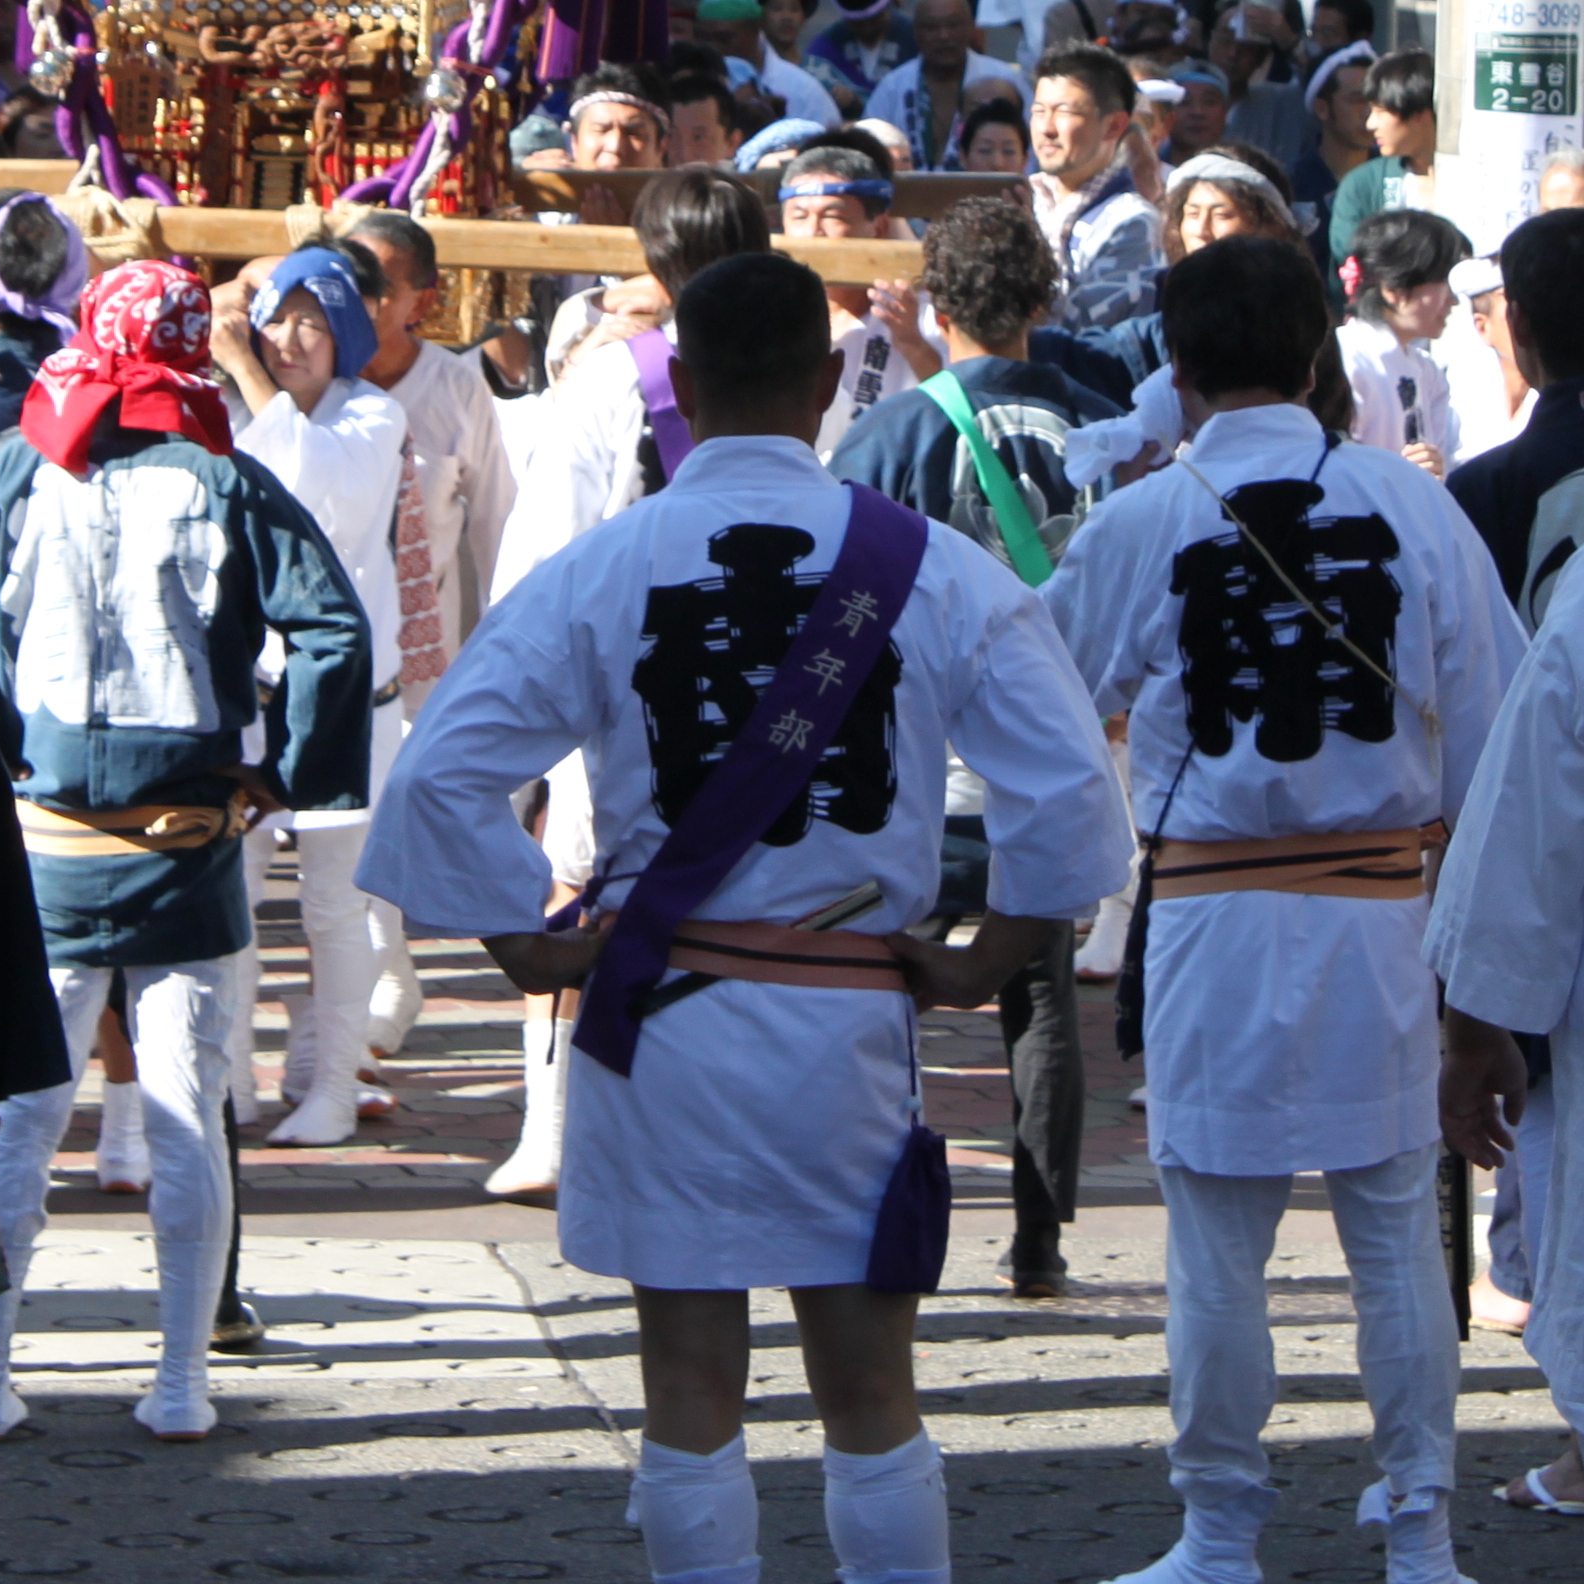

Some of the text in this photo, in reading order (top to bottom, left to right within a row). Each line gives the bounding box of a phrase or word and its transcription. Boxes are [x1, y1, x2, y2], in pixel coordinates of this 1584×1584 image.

[1490, 59, 1565, 87] 東雪谷
[1491, 88, 1564, 111] 2-20
[768, 590, 879, 755] 青年部
